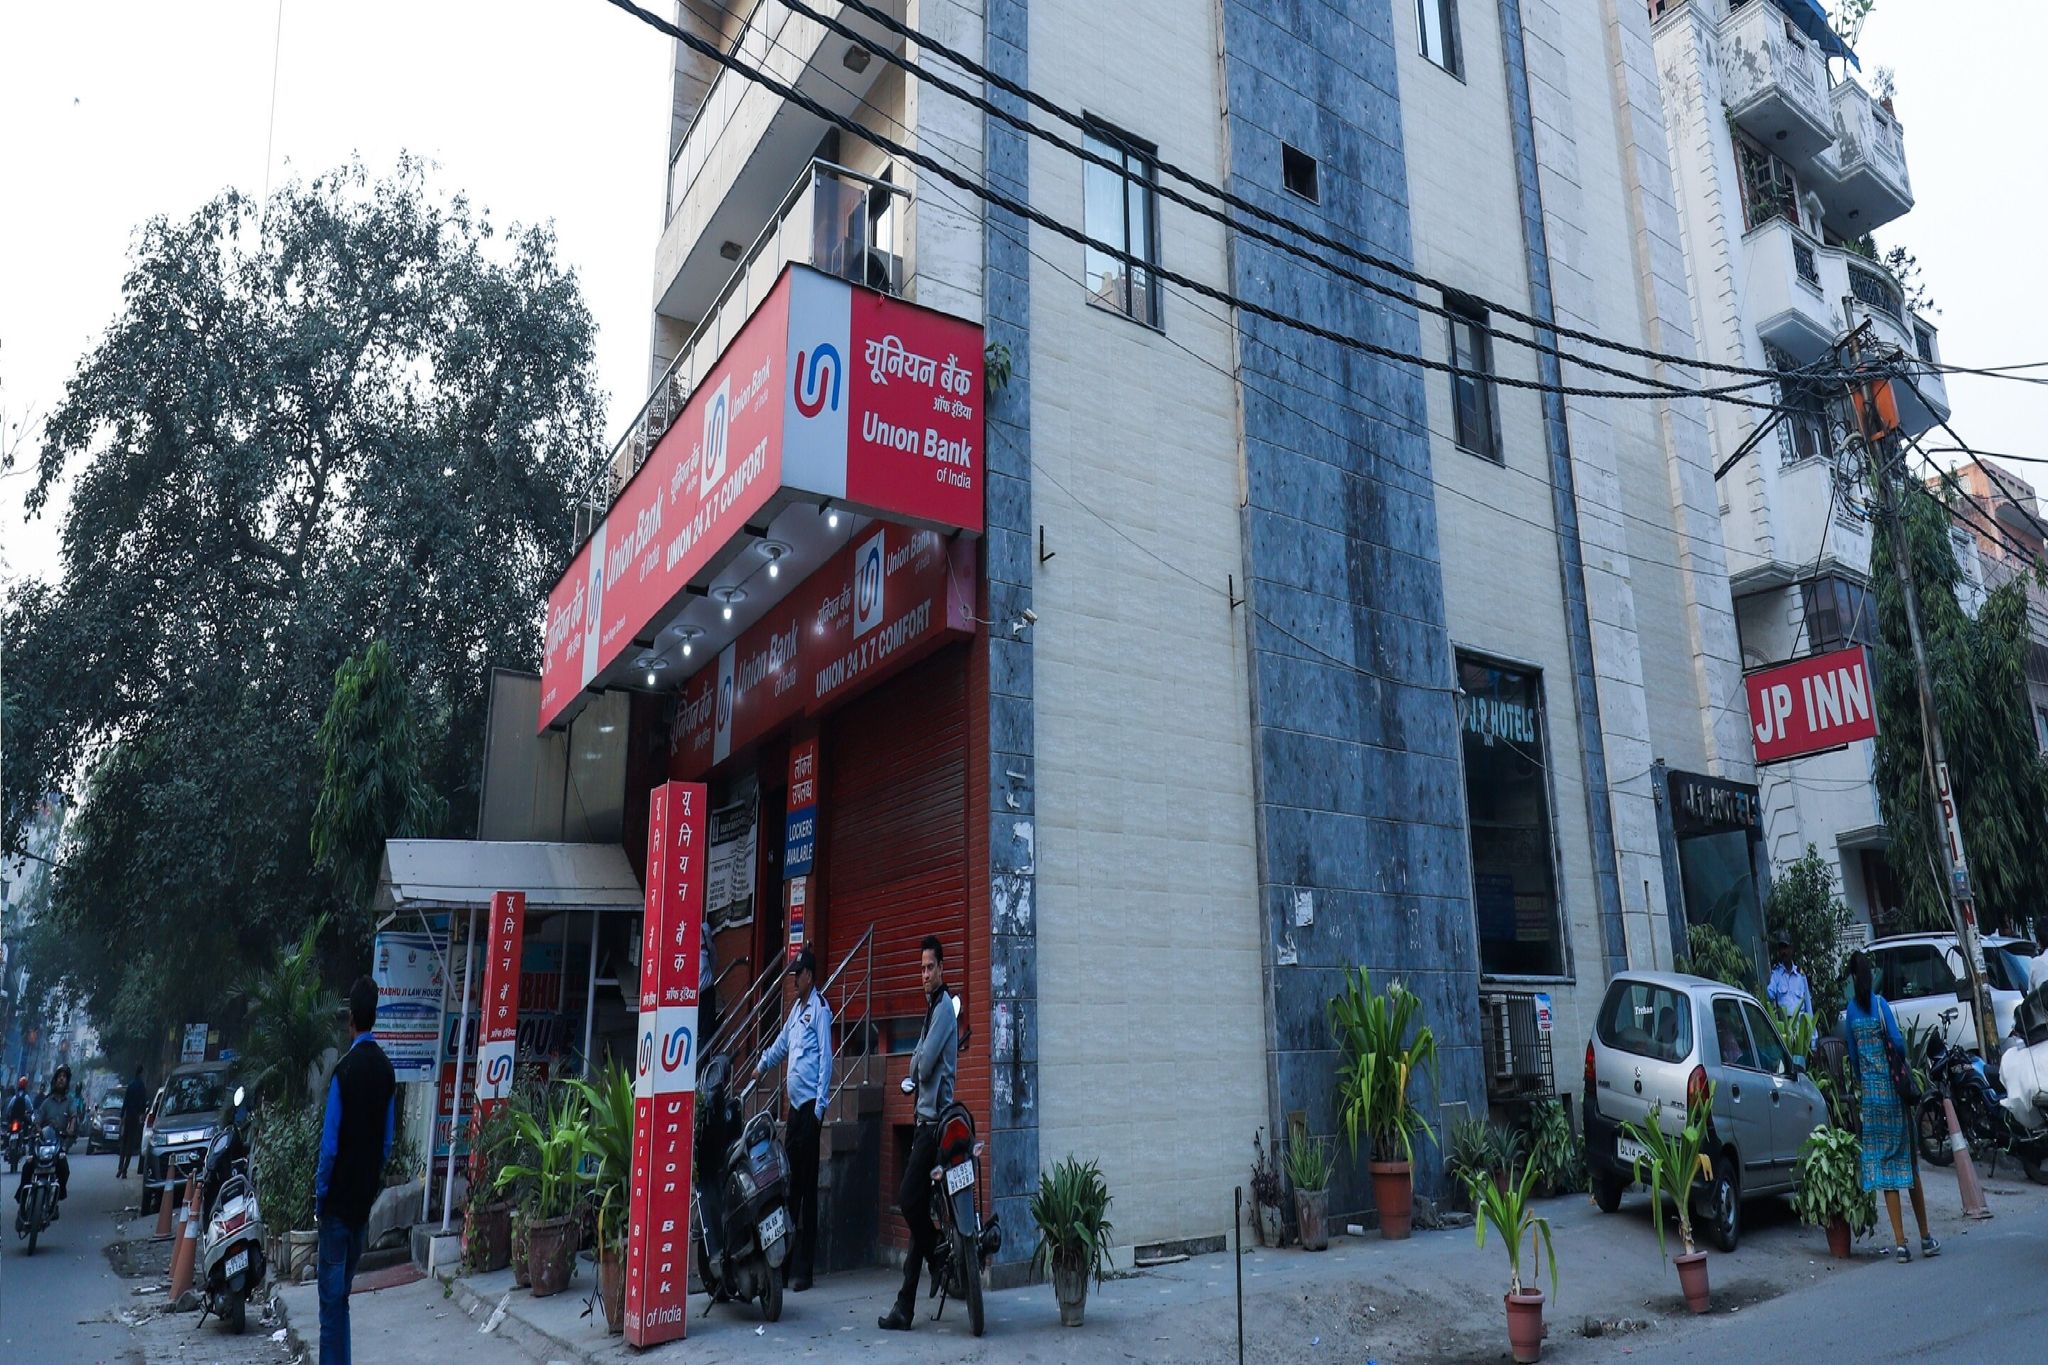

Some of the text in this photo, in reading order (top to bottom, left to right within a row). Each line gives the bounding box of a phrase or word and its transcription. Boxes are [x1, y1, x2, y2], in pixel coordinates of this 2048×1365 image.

[731, 354, 771, 423] Union Bank
[864, 334, 972, 396] यूनियन बैंक
[933, 395, 972, 420] ऑफ इंडिया
[862, 410, 972, 468] Union Bank
[666, 436, 768, 573] UNION 24 X 7 COMFORT
[937, 467, 971, 489] of India
[606, 531, 635, 592] Union
[635, 486, 664, 558] Bank
[887, 542, 910, 577] Union
[738, 619, 798, 699] Union Bank
[816, 598, 932, 698] UNION 24 X 7 COMFORT
[1490, 700, 1534, 742] HOTELS
[1756, 664, 1870, 743] JP INN
[786, 843, 813, 866] AVAILABLE
[788, 819, 813, 842] LOCKERS
[674, 790, 692, 972] यूनियन बैंक
[408, 988, 421, 996] LAW
[422, 988, 442, 997] HOUSE
[664, 990, 679, 1001] ऑफ
[1634, 1006, 1653, 1015] Trehan
[631, 1106, 646, 1297] Union Bank
[659, 1102, 681, 1294] Union Bank
[646, 1304, 682, 1328] of India
